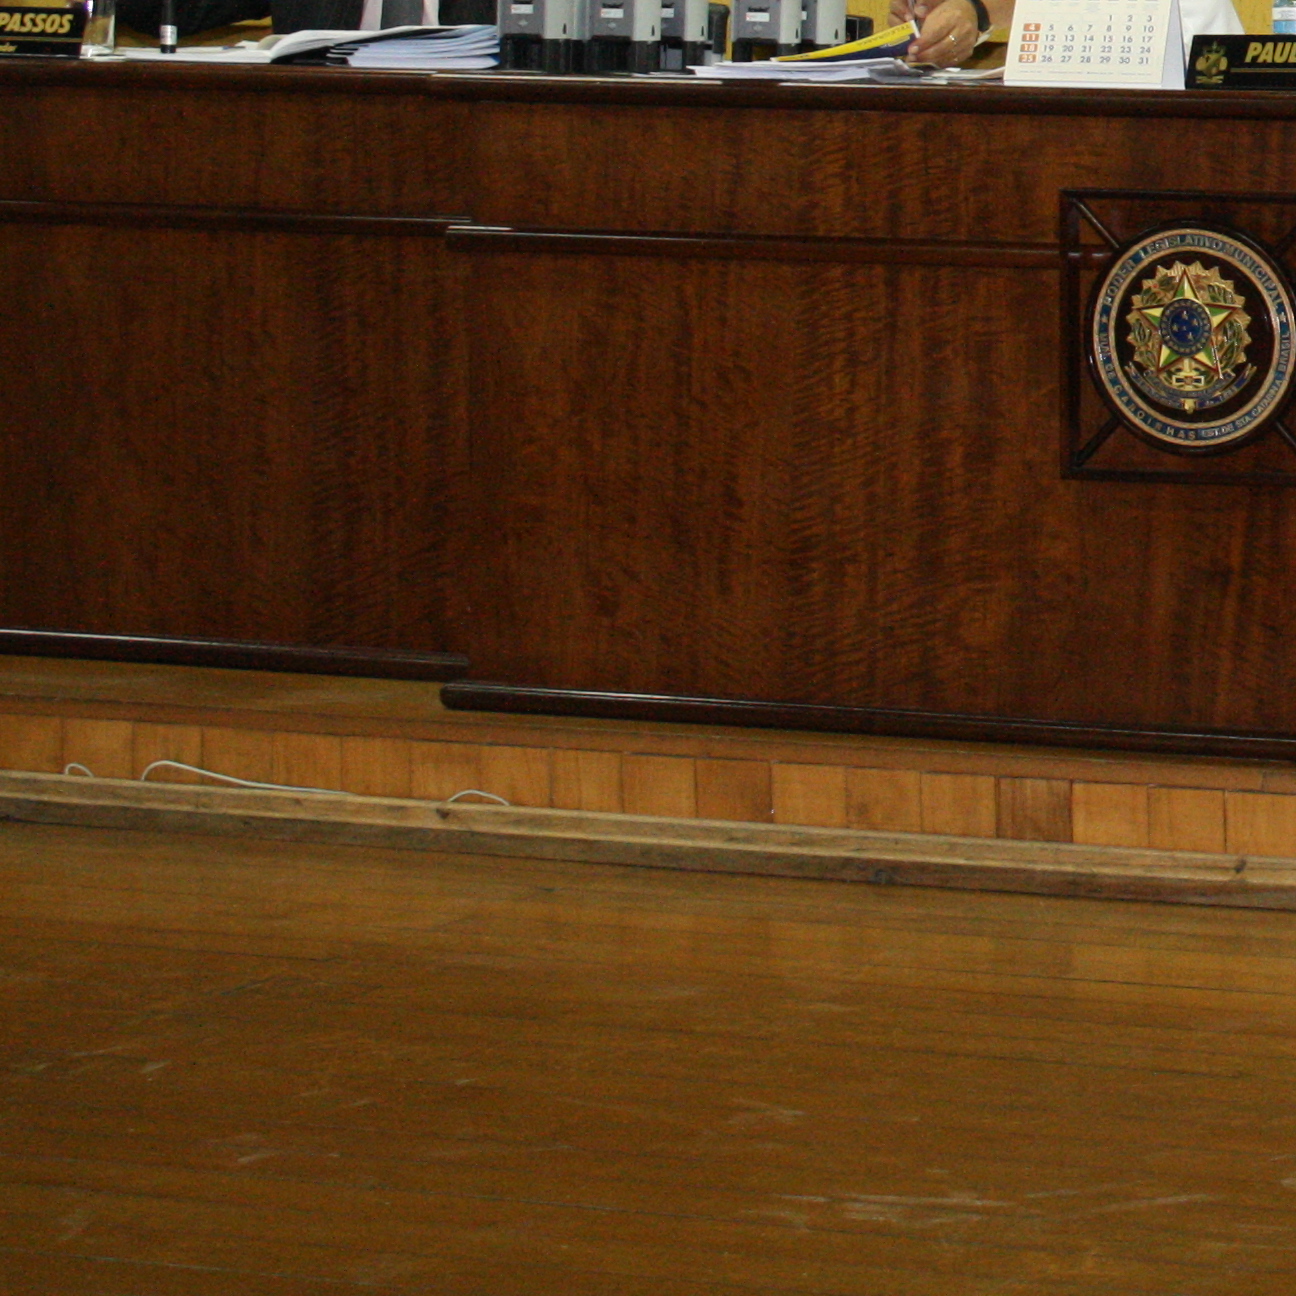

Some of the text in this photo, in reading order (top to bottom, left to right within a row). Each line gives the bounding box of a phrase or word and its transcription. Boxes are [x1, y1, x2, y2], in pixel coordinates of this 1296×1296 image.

[0, 12, 74, 33] PASSOS
[1144, 25, 1154, 33] 10
[1045, 34, 1056, 42] 12
[1065, 34, 1074, 42] 13
[1103, 35, 1113, 43] 15
[1062, 45, 1074, 53] 20
[1081, 45, 1092, 53] 21
[1101, 45, 1112, 53] 22
[1140, 46, 1151, 54] 24
[1041, 55, 1053, 63] 26
[1060, 55, 1072, 63] 27
[1099, 56, 1111, 64] 29
[1138, 57, 1149, 65] 31
[1103, 234, 1283, 308] PODER LEGISLATIVO MUNICIPAL
[1114, 384, 1196, 440] CANOINHAS
[1251, 378, 1284, 418] CATARINA
